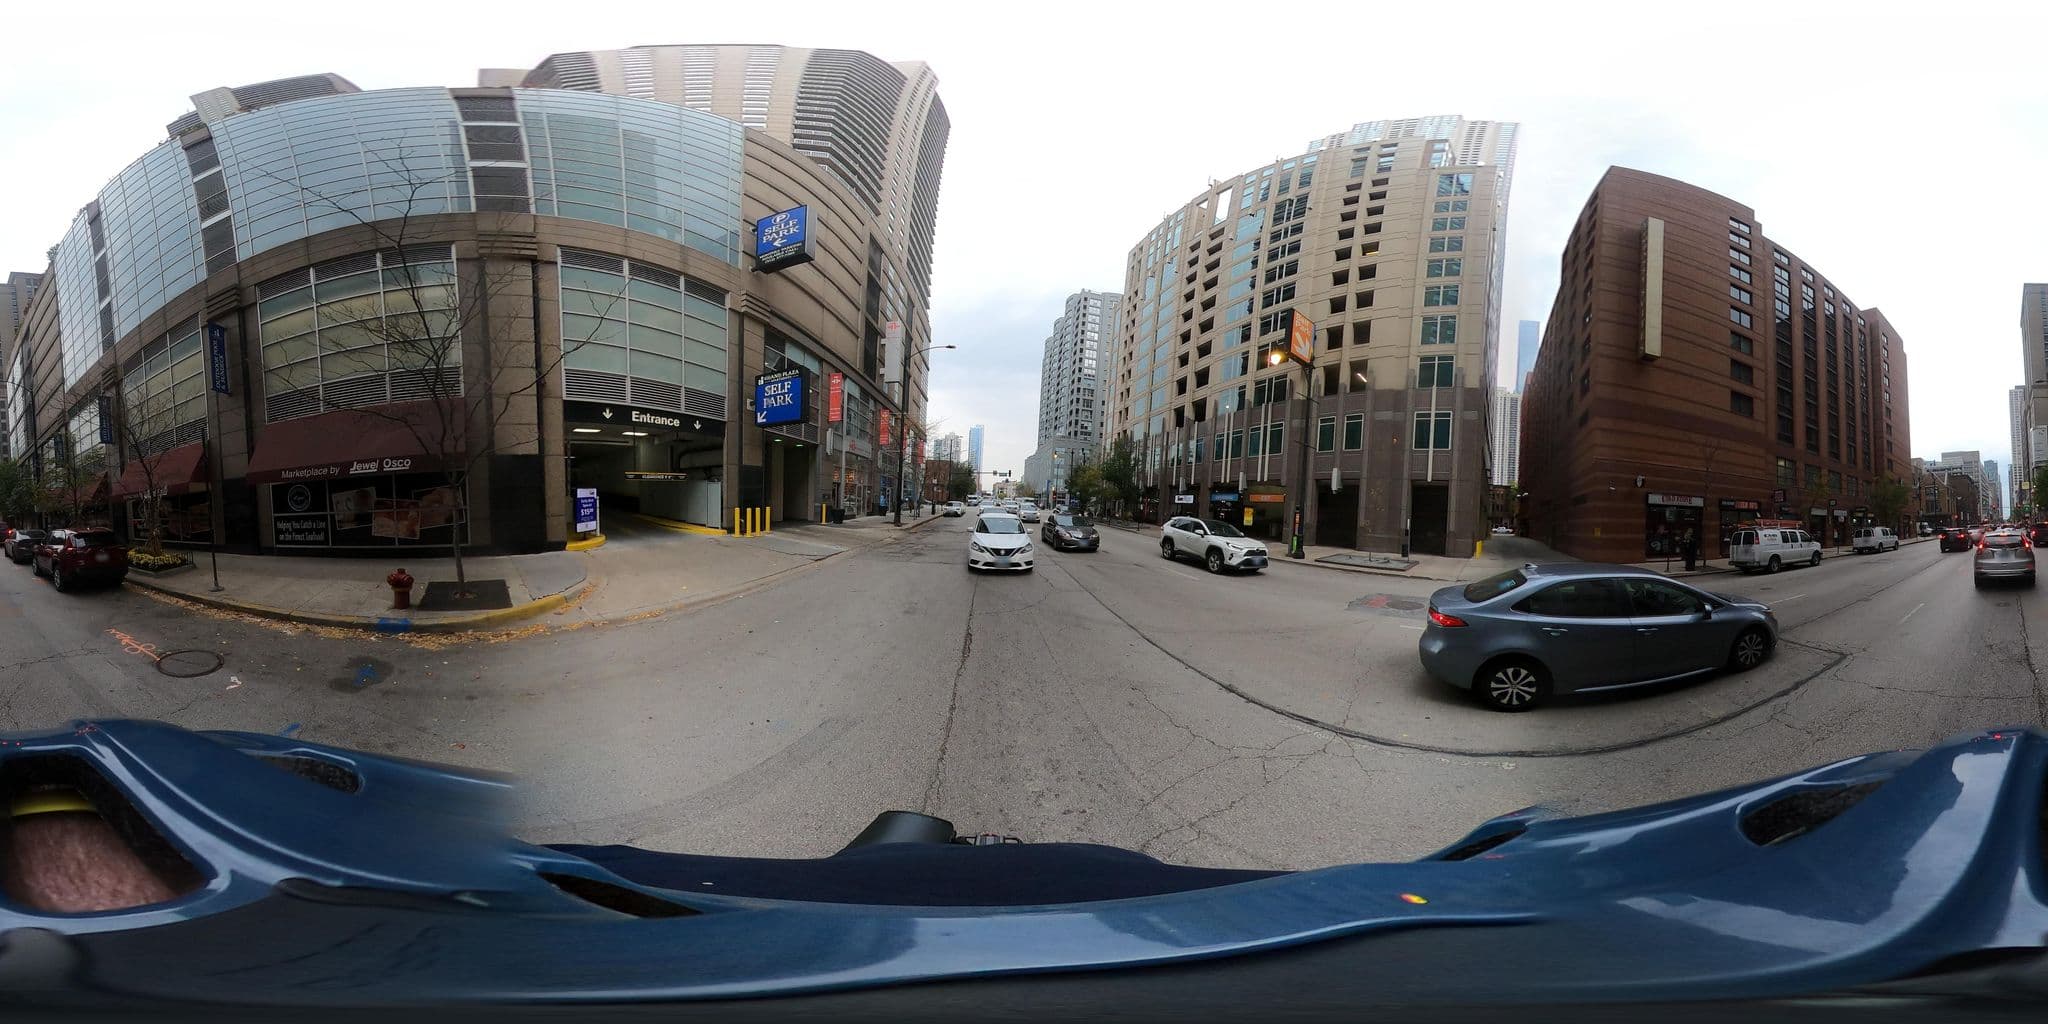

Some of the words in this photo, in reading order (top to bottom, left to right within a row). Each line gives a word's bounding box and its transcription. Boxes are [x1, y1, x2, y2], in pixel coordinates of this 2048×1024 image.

[762, 225, 800, 243] PARK
[764, 219, 798, 235] SELF
[782, 369, 800, 377] PLAZA
[764, 381, 792, 397] SELF
[763, 393, 793, 408] PARK
[631, 410, 680, 427] Entrance
[281, 467, 328, 479] Marketplace
[330, 466, 340, 475] by
[350, 459, 379, 473] Jewel
[383, 458, 411, 470] Osco
